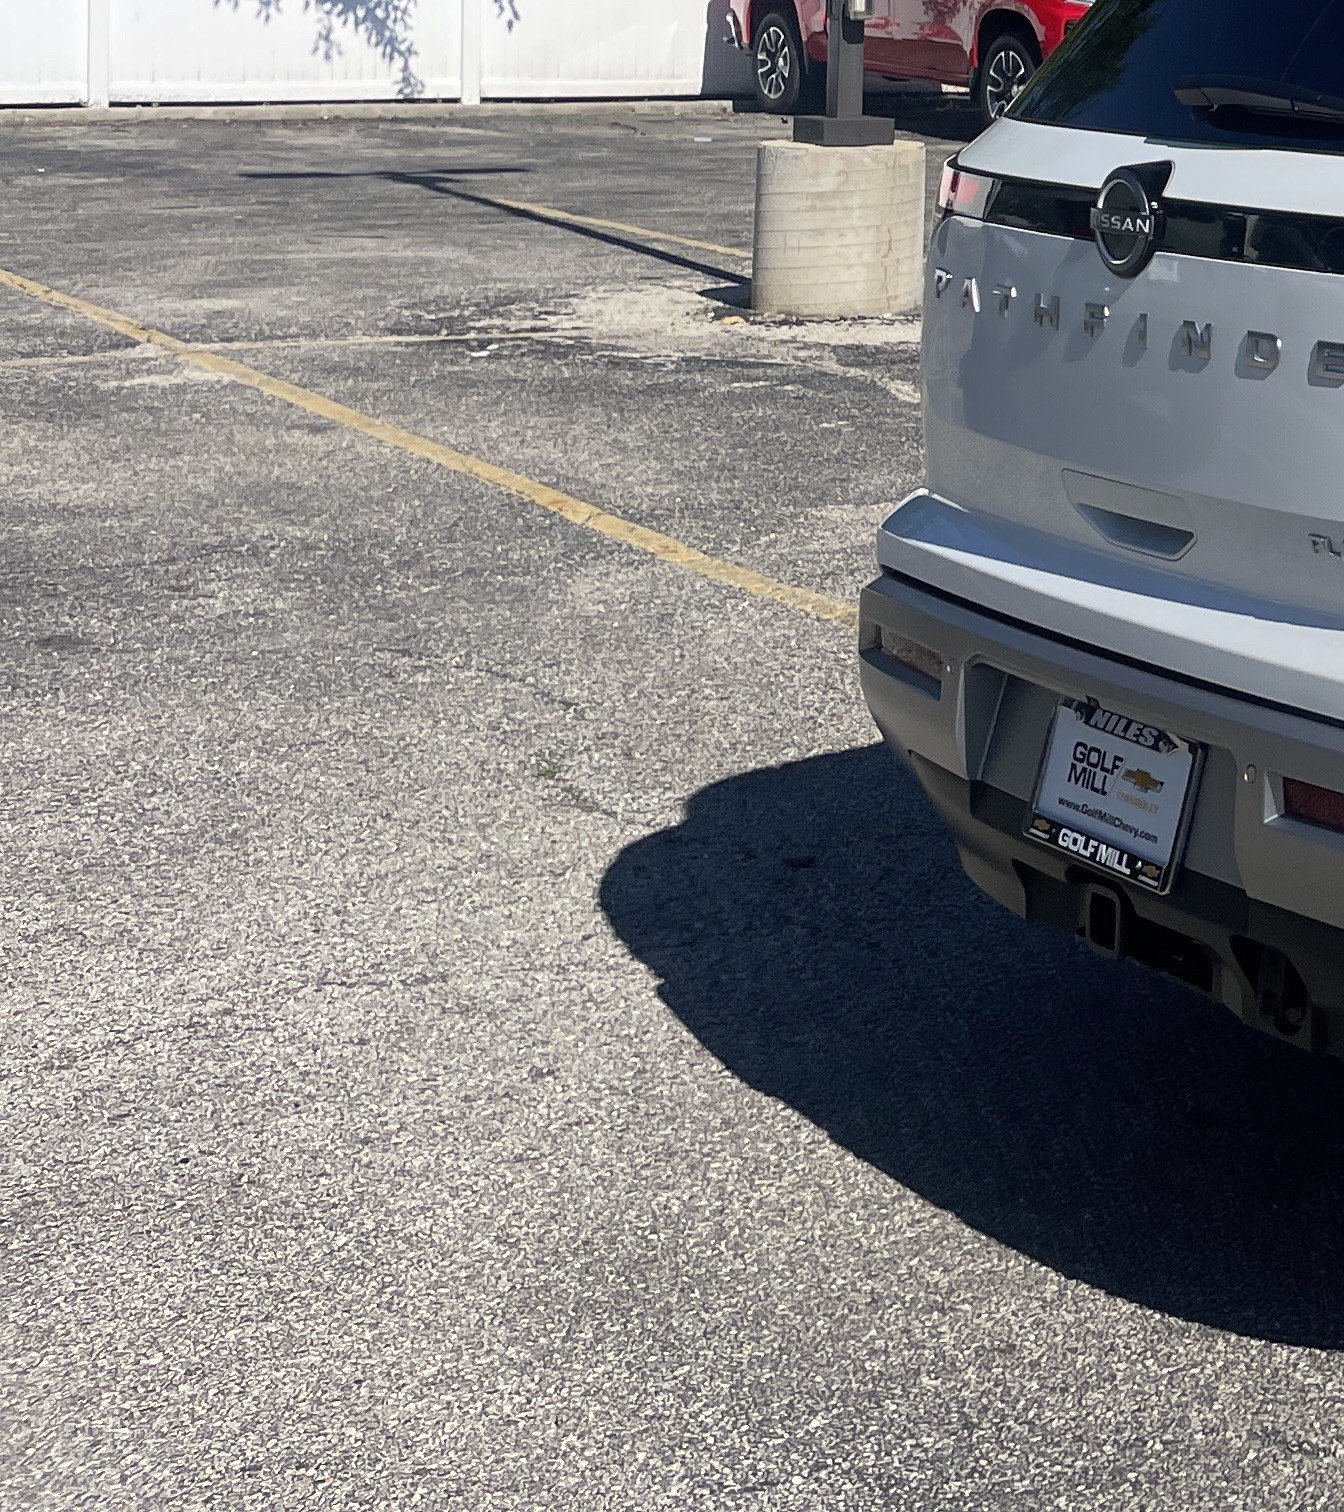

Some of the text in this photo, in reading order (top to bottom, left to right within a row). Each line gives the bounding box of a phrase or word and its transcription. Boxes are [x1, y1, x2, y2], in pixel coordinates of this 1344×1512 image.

[1090, 709, 1159, 747] NILES
[1073, 741, 1125, 775] GOLF
[1067, 762, 1109, 797] MILL
[1058, 796, 1158, 844] www.GolfMillChevy.com
[1058, 828, 1131, 875] GOLF MILL
